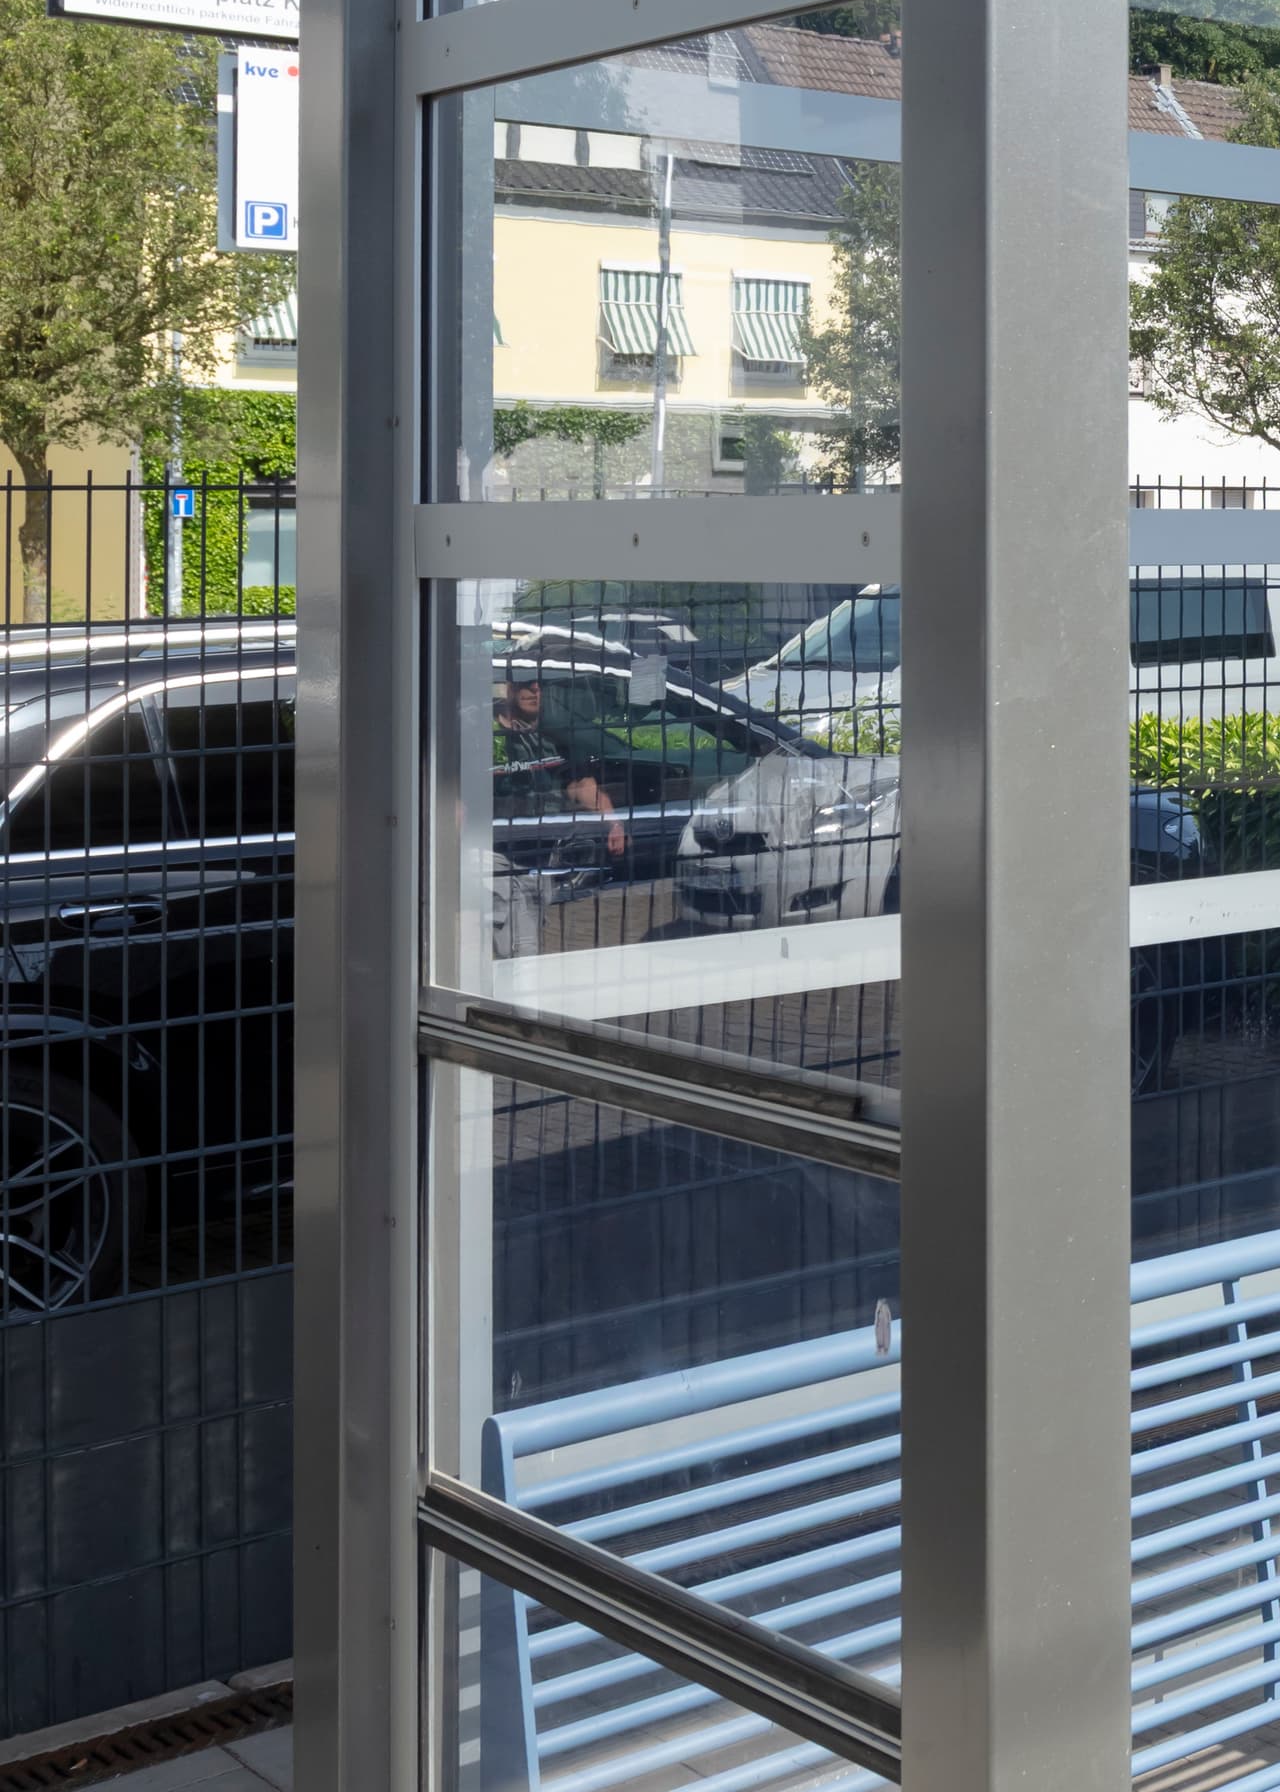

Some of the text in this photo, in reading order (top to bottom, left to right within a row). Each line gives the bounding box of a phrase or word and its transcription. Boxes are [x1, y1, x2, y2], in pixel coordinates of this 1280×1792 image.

[199, 6, 261, 25] parkende
[244, 61, 280, 79] kve
[253, 204, 280, 236] P
